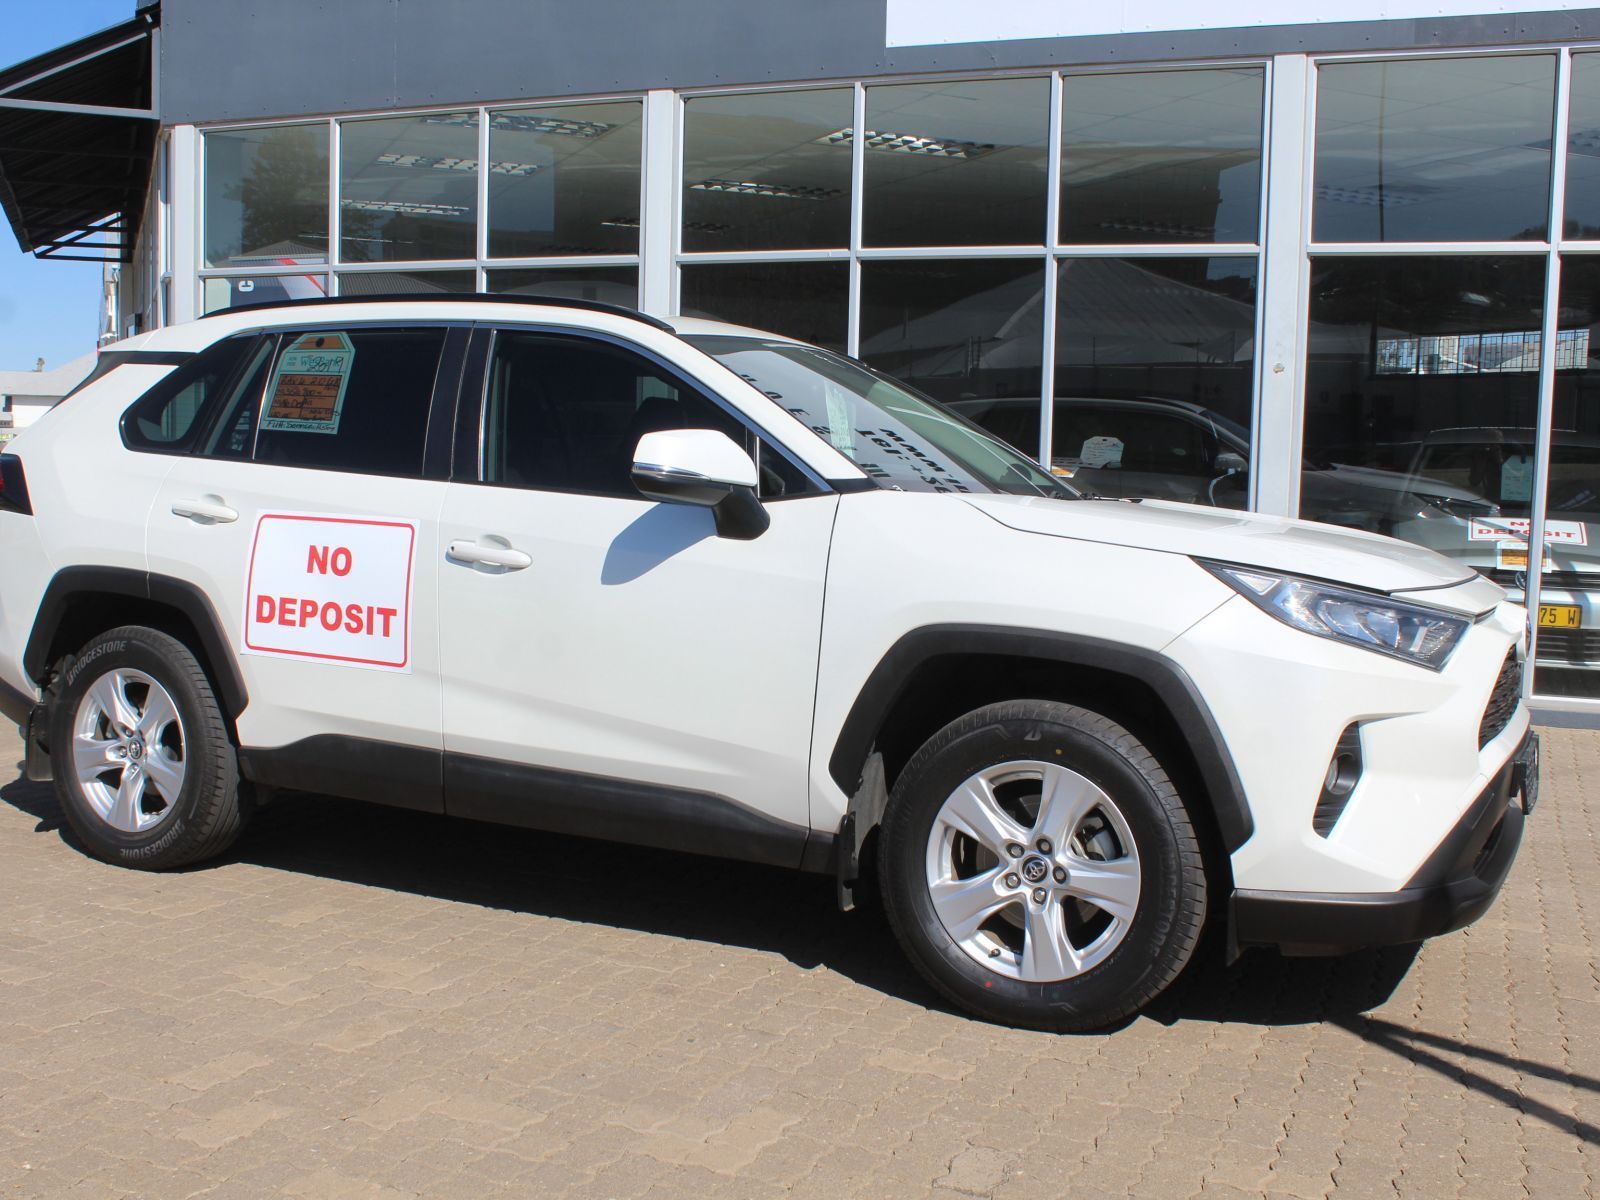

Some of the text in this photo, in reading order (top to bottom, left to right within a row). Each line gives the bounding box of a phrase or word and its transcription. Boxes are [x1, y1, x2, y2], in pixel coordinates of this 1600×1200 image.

[307, 545, 353, 577] NO
[255, 594, 397, 638] DEPOSIT
[1567, 610, 1577, 625] W
[66, 640, 127, 687] BRIDGESTONE
